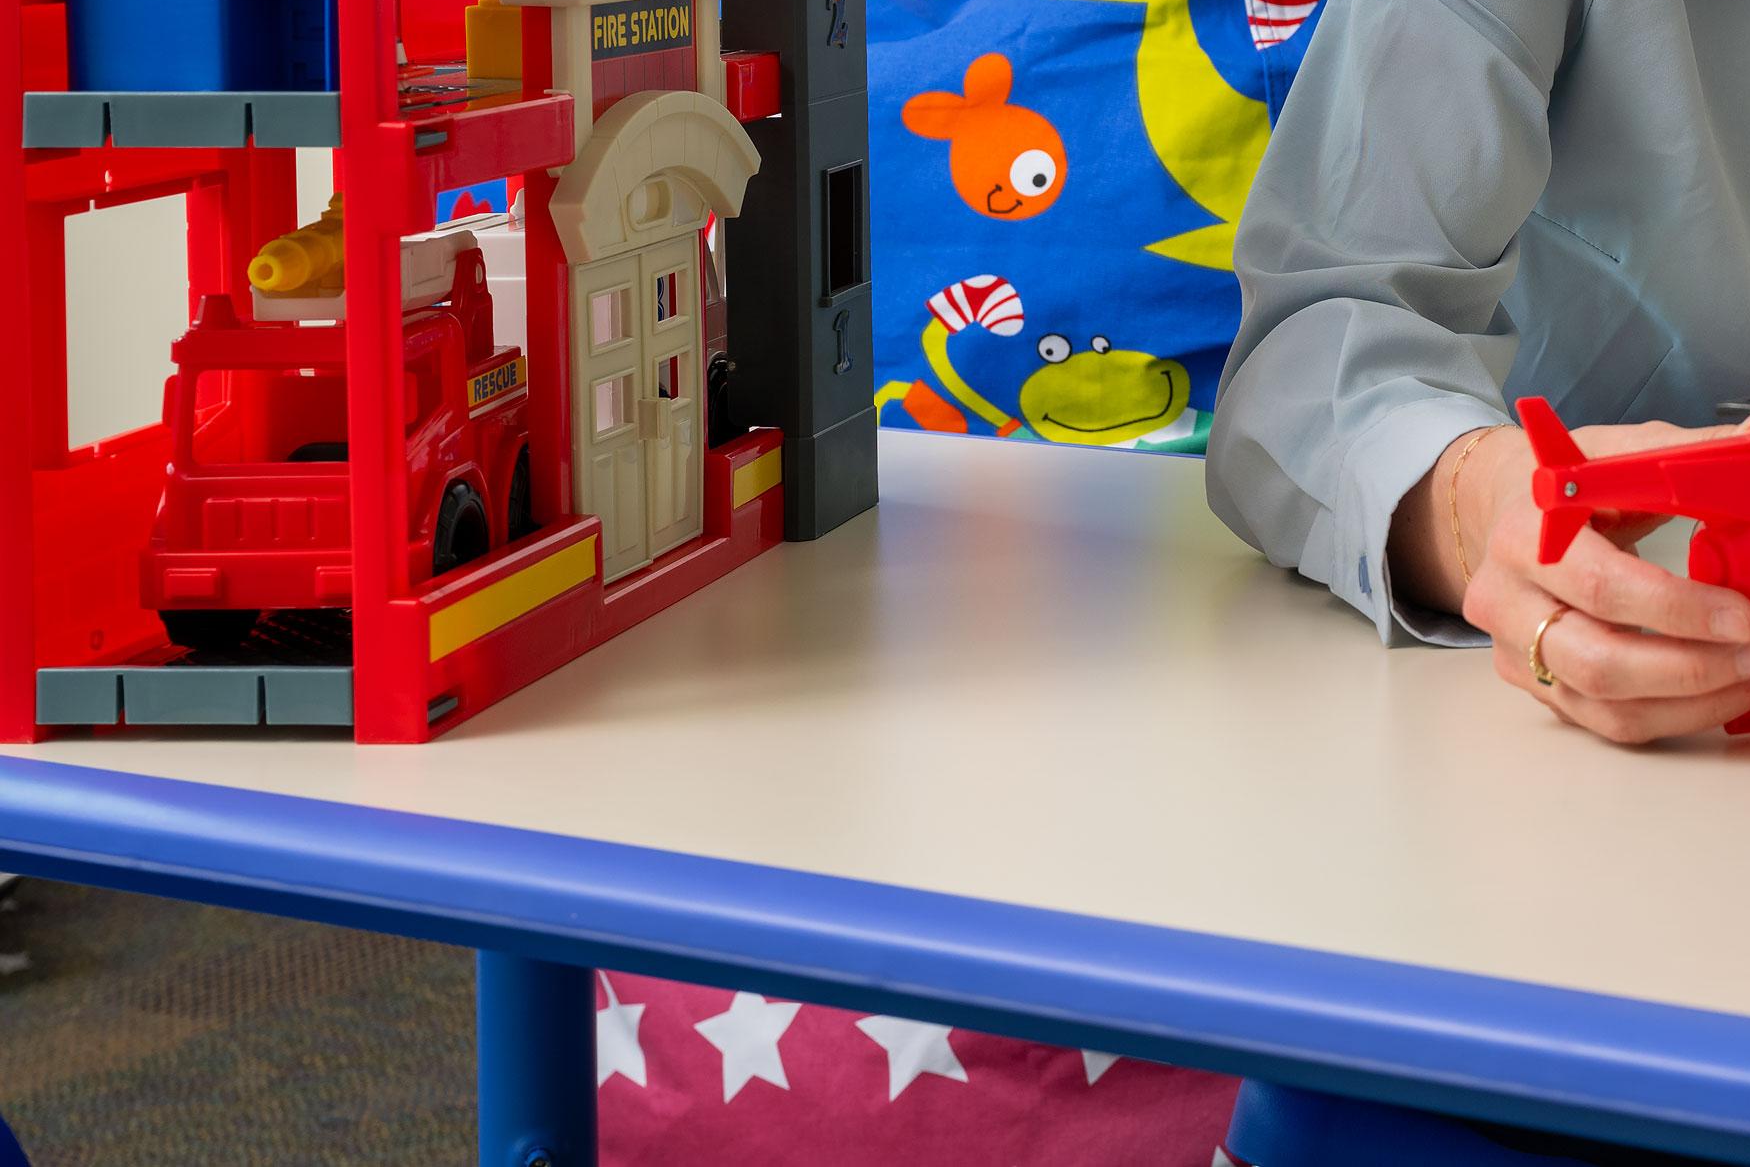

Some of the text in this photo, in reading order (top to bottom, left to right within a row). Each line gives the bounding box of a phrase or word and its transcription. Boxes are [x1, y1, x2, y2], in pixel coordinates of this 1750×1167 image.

[594, 5, 689, 50] FIRE STATION
[832, 309, 853, 375] 1
[474, 362, 517, 403] RESCUE
